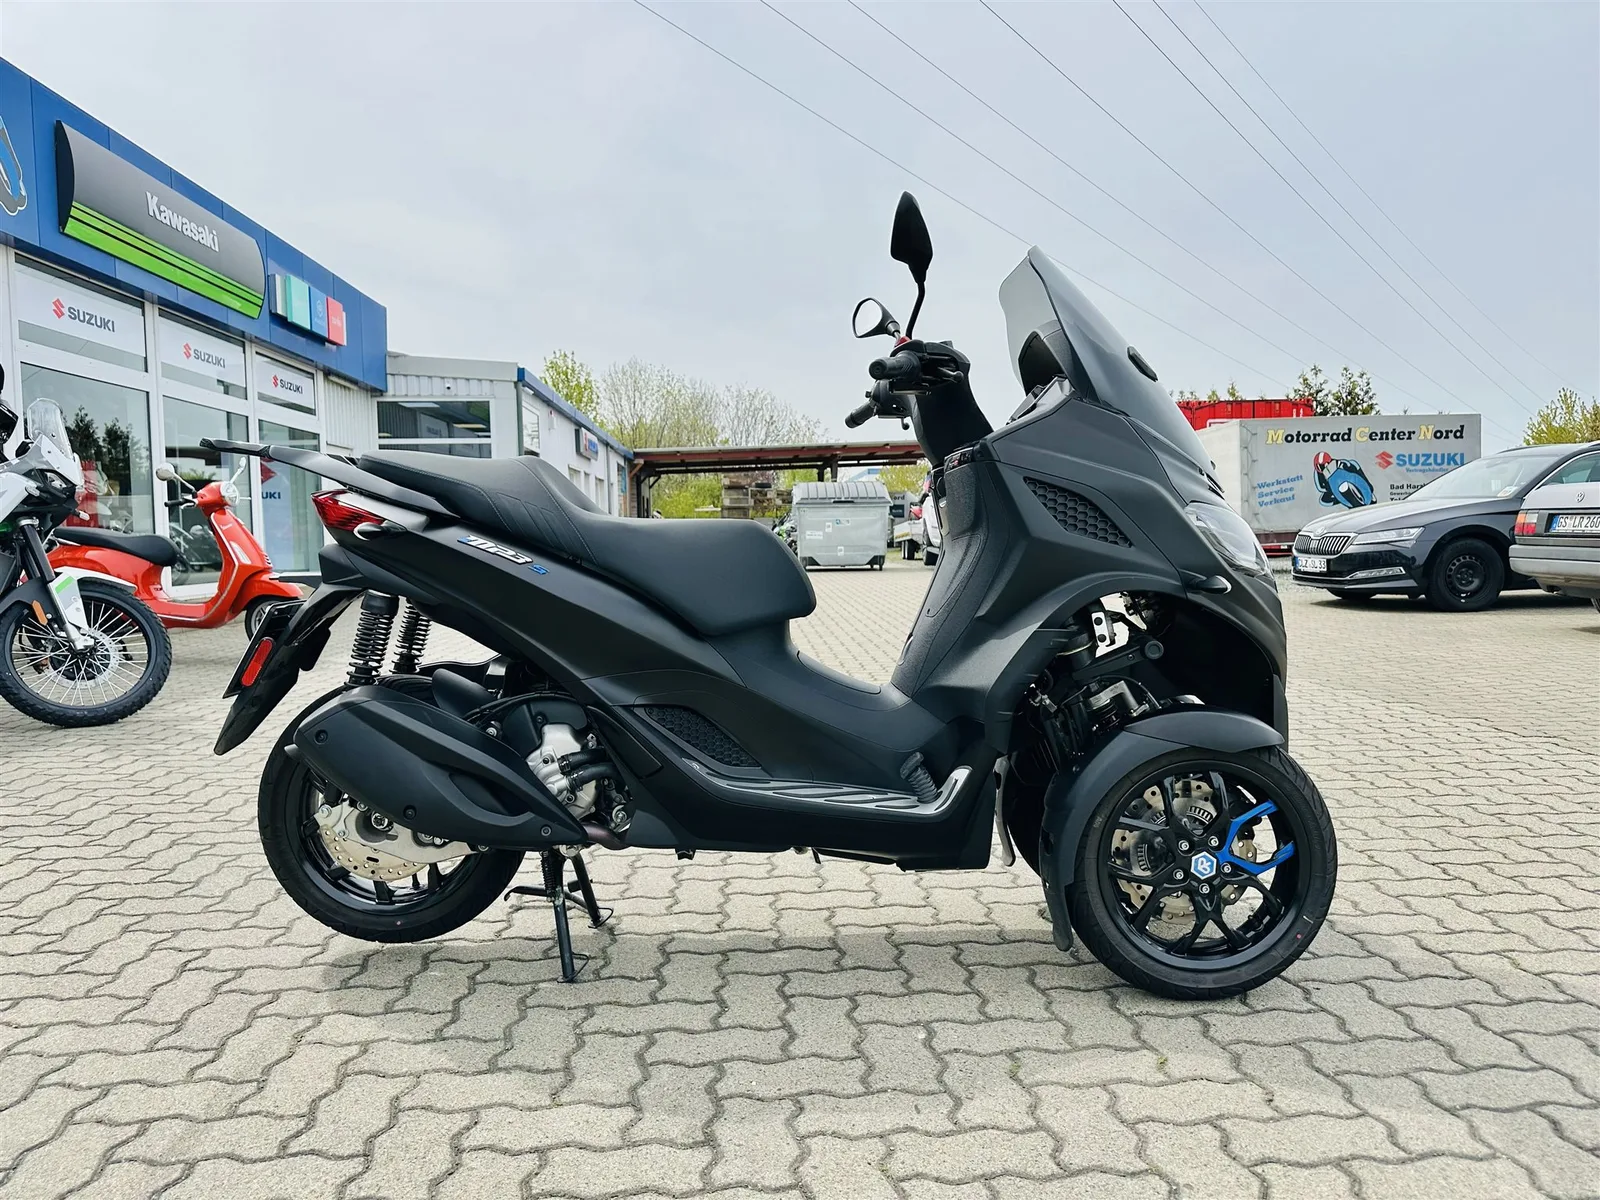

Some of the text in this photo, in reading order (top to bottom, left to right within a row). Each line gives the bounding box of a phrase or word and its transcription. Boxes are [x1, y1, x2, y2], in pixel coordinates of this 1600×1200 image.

[145, 191, 219, 252] Kawasaki
[68, 306, 115, 332] SUZUKI
[193, 348, 226, 369] SUZUKI
[280, 379, 303, 394] SUZUKI
[1266, 424, 1465, 445] Motorrad Center Nord
[1396, 452, 1465, 467] SUZUKI
[1256, 474, 1303, 490] Werkstatt
[1258, 486, 1295, 499] Service
[1258, 494, 1295, 508] Verkauf
[1558, 516, 1568, 528] GS
[1572, 516, 1584, 529] LR
